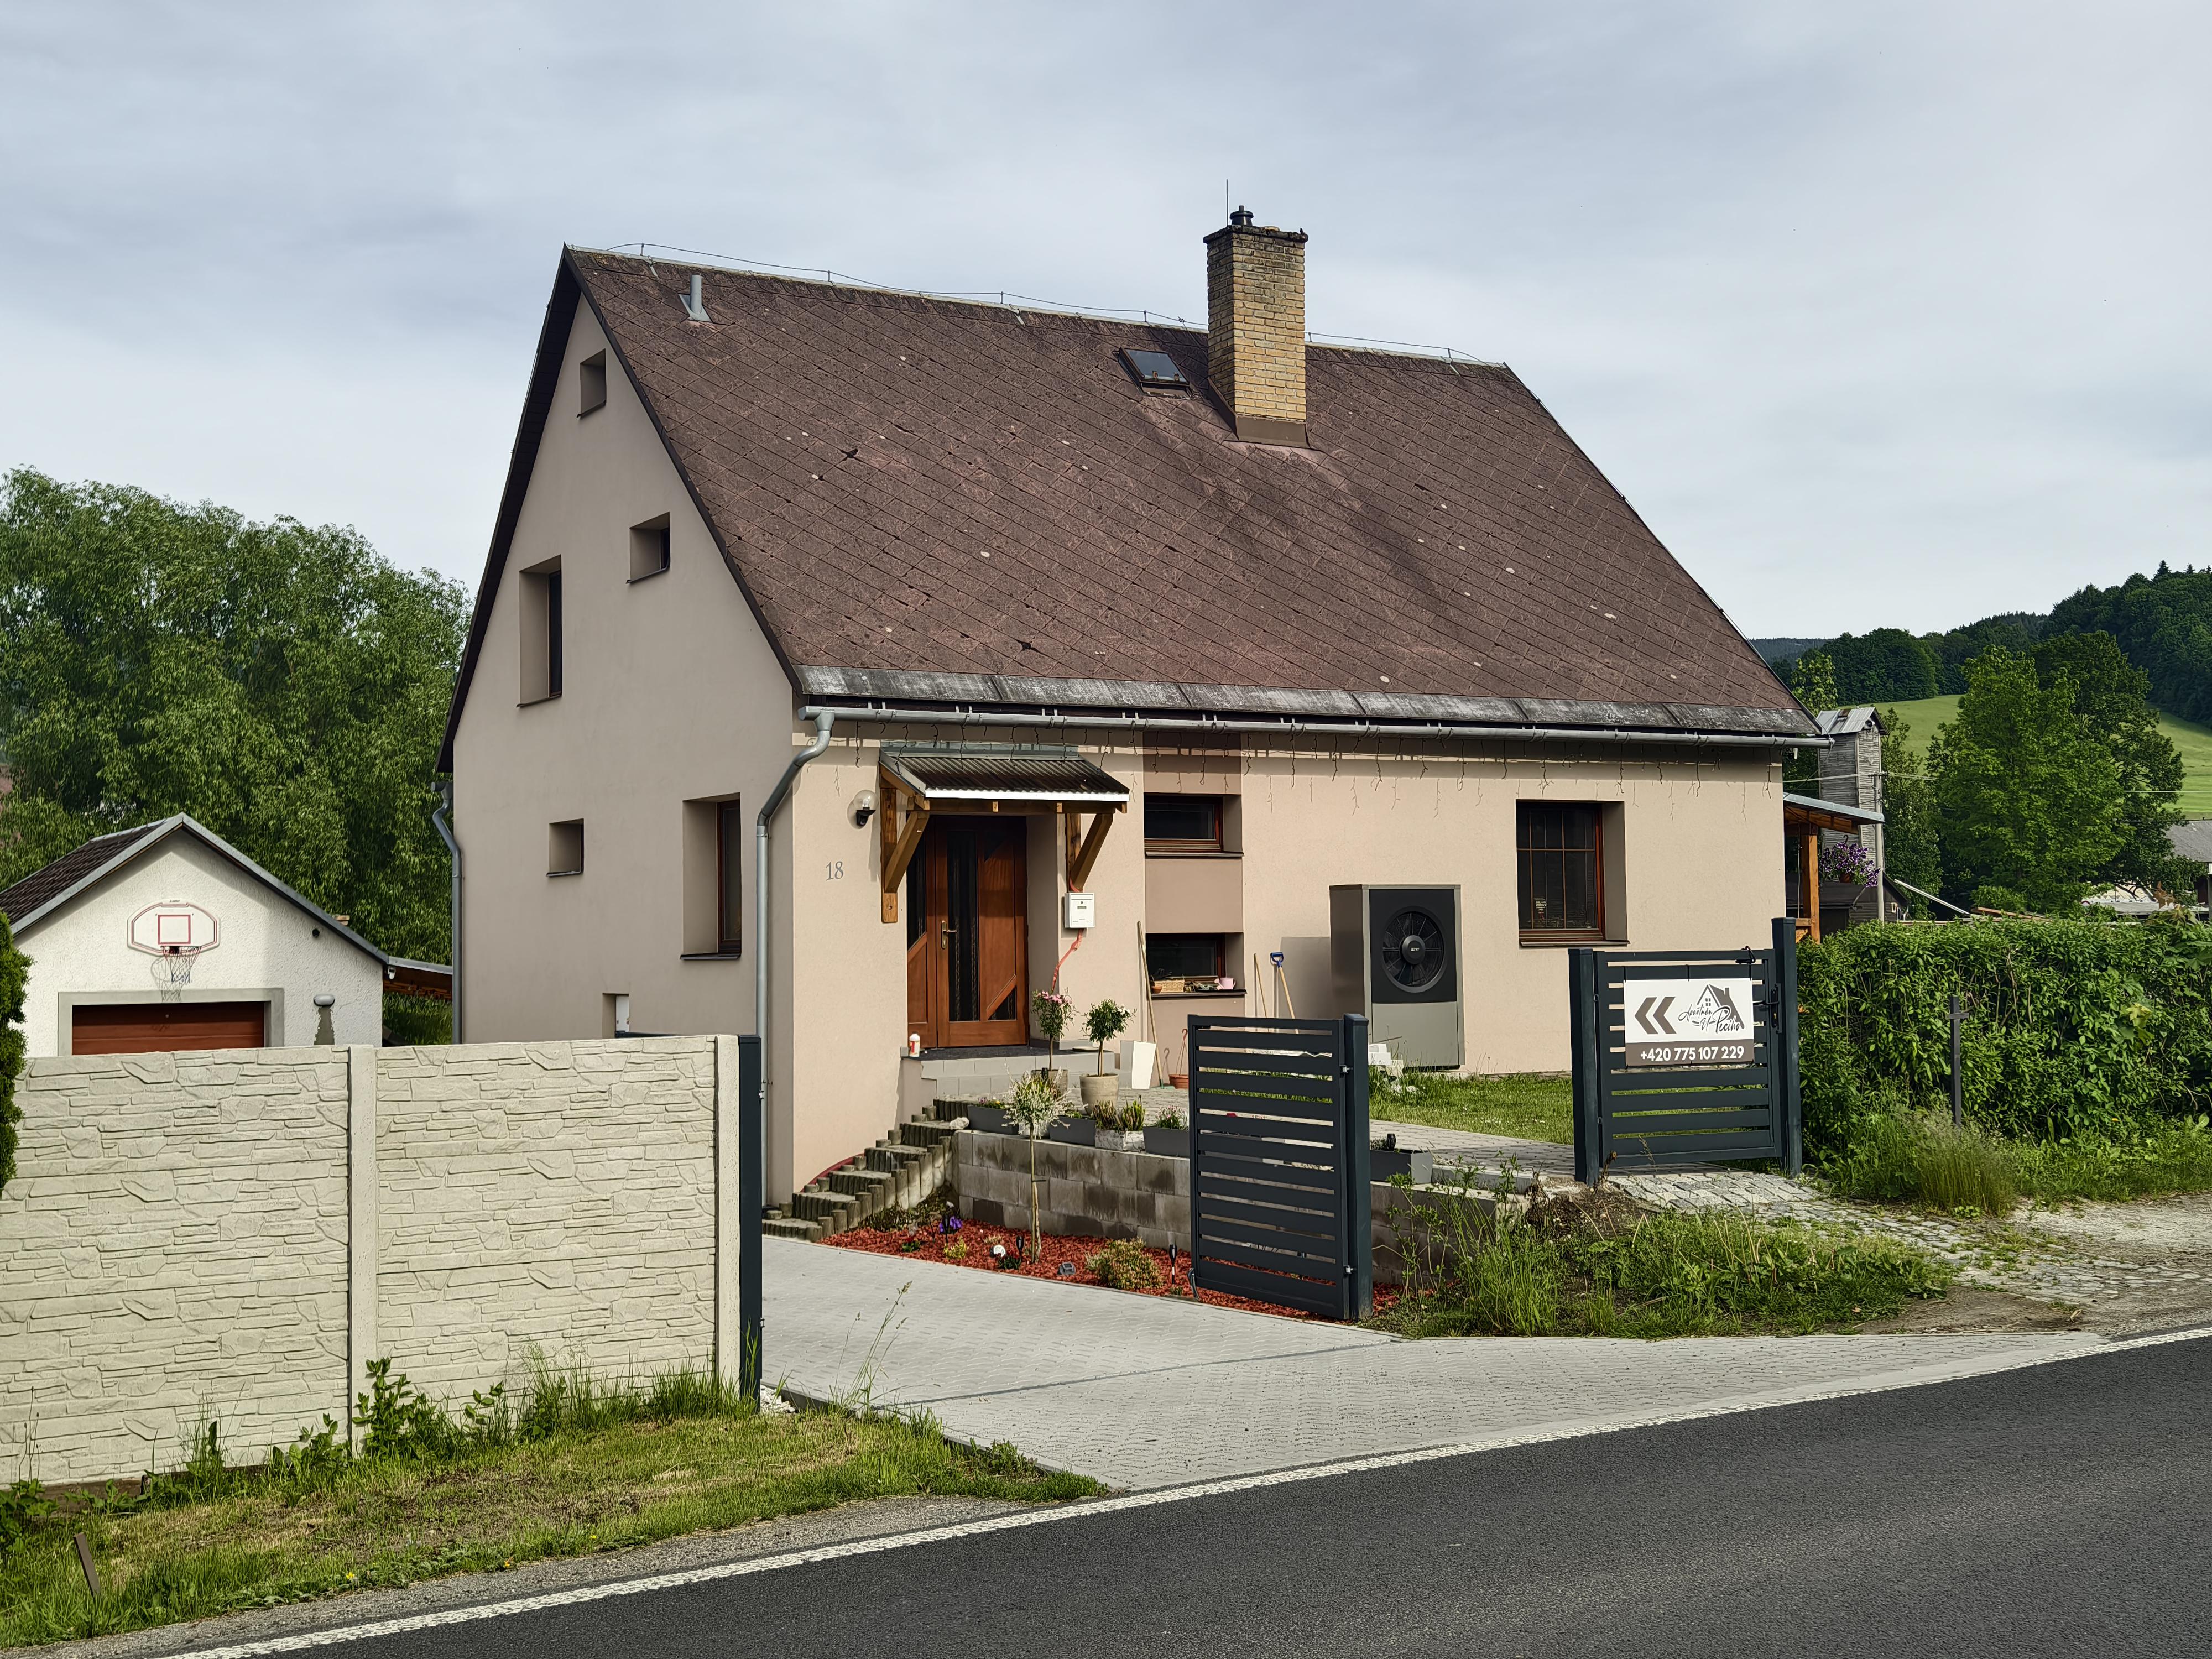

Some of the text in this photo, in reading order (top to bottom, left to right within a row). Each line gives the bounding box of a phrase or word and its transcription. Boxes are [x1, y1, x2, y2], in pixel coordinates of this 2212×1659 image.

[826, 861, 844, 881] 18
[1640, 1045, 1744, 1062] +420 775 107 229
